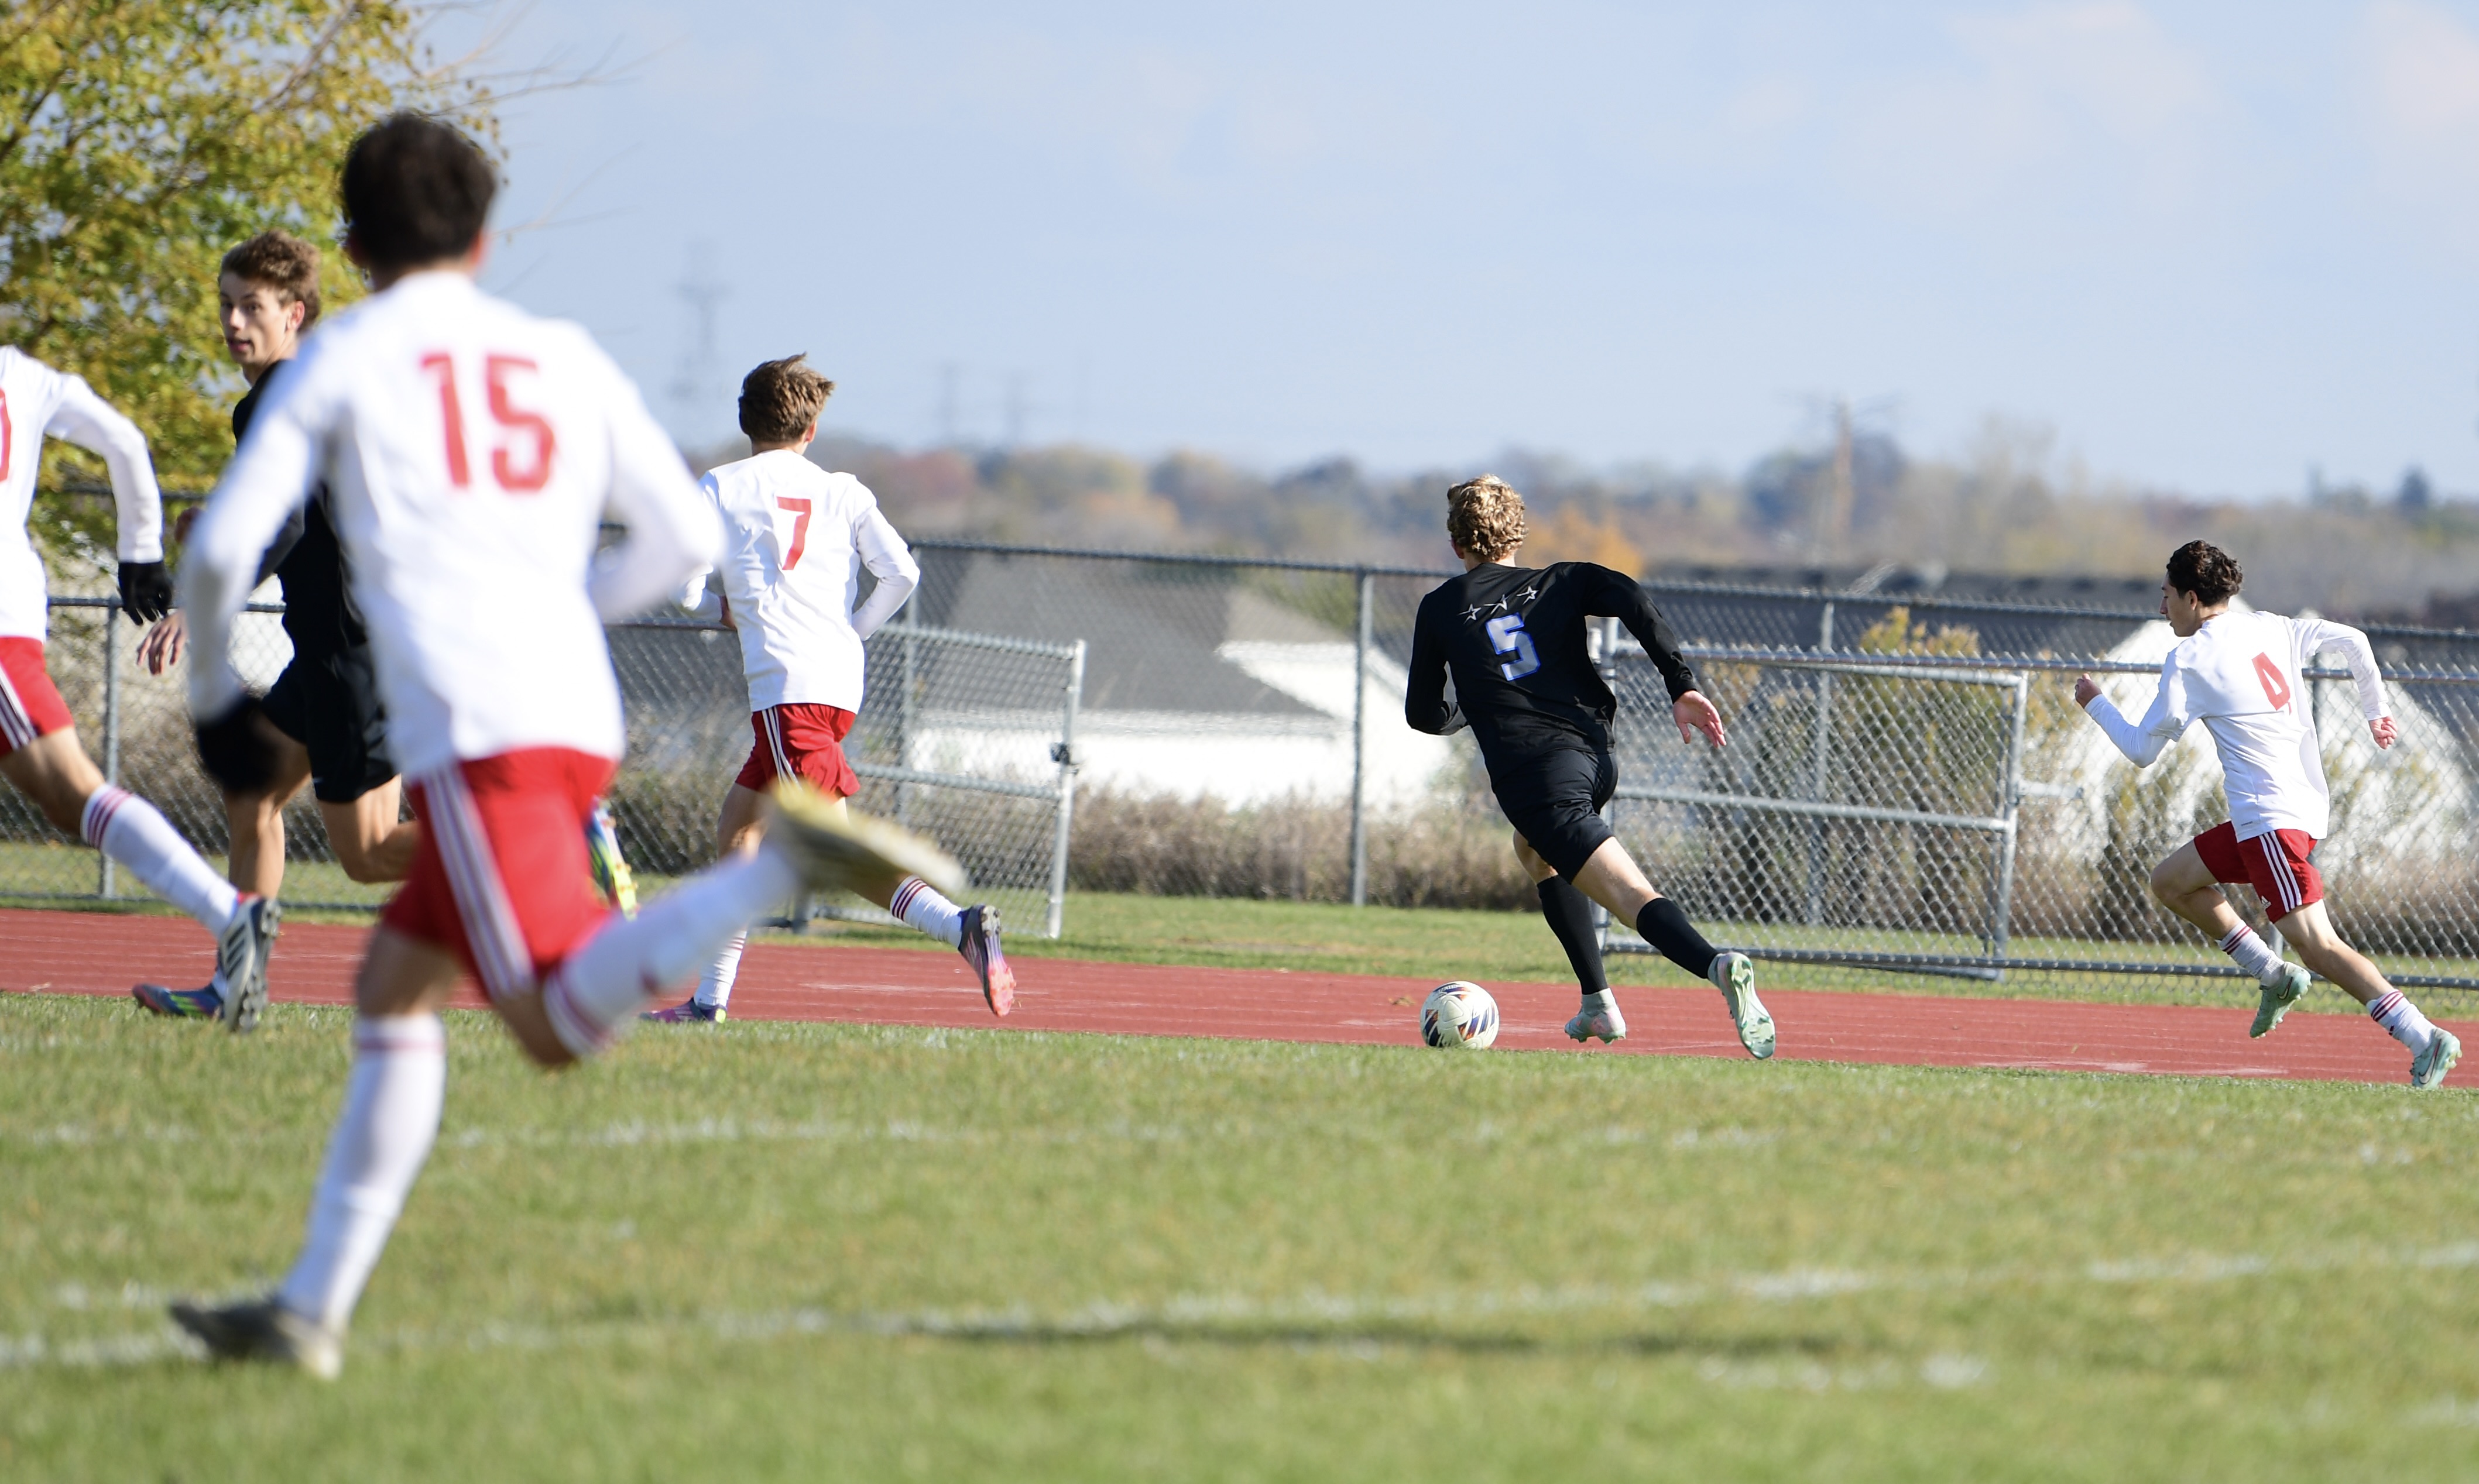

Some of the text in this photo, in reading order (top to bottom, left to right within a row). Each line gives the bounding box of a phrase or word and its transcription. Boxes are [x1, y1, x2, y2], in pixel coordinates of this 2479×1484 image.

[421, 351, 555, 492] 15
[776, 496, 811, 571] 7
[1484, 612, 1541, 682] 5
[2251, 651, 2292, 716] 4
